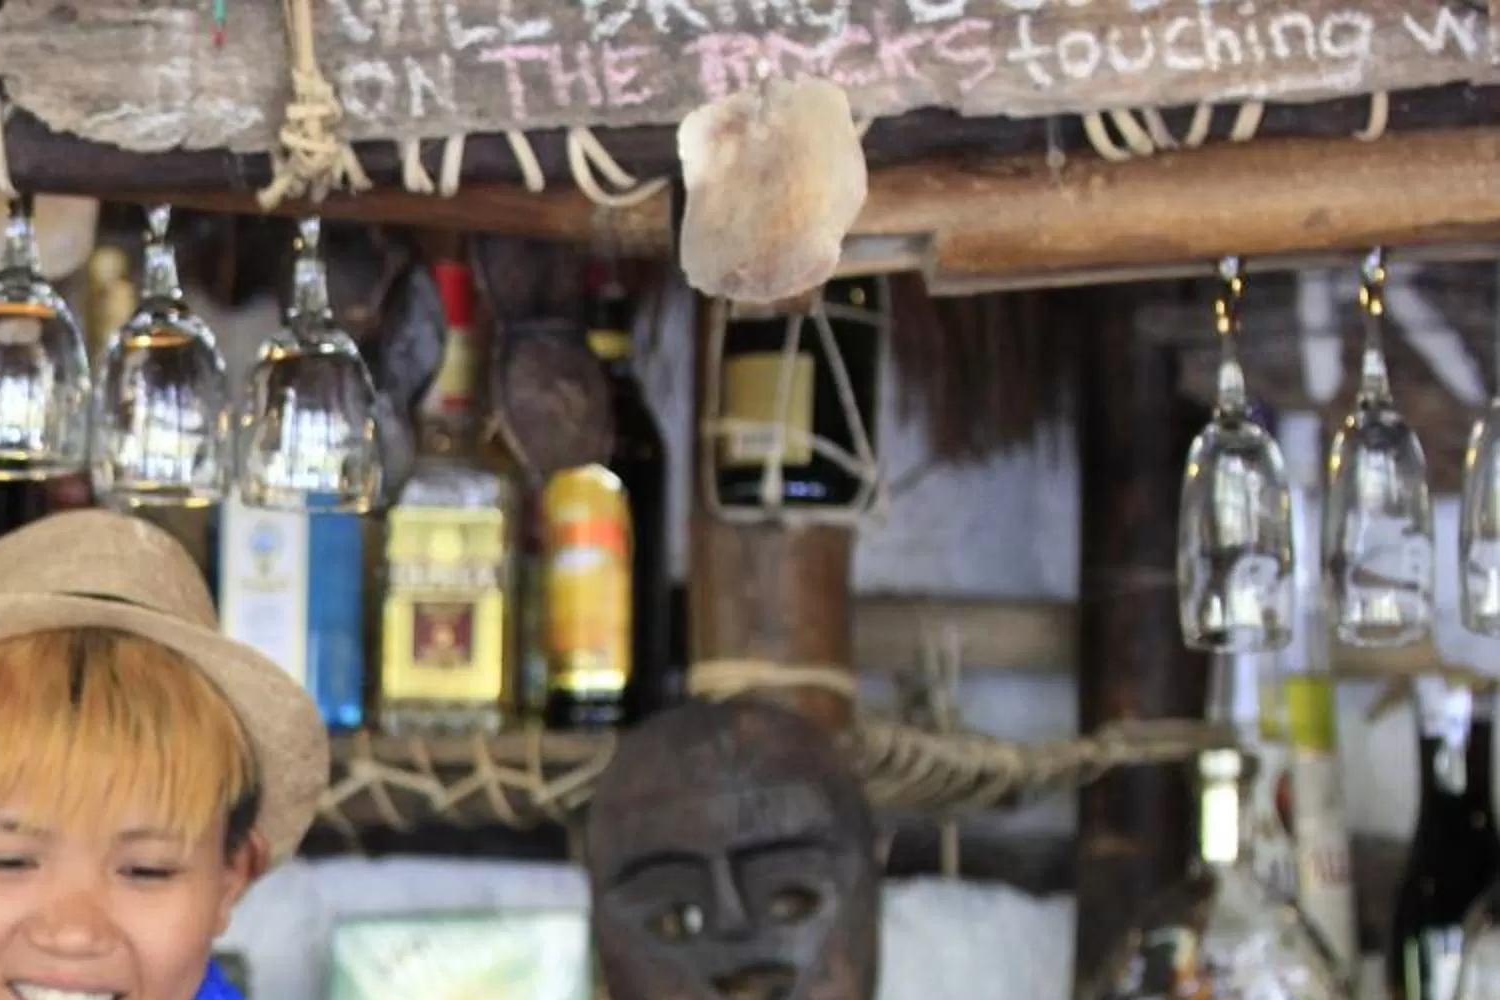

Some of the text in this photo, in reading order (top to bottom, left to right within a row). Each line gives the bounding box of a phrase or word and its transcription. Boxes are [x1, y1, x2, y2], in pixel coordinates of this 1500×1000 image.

[340, 50, 457, 122] ON
[477, 40, 663, 121] THE
[1007, 0, 1373, 88] touching
